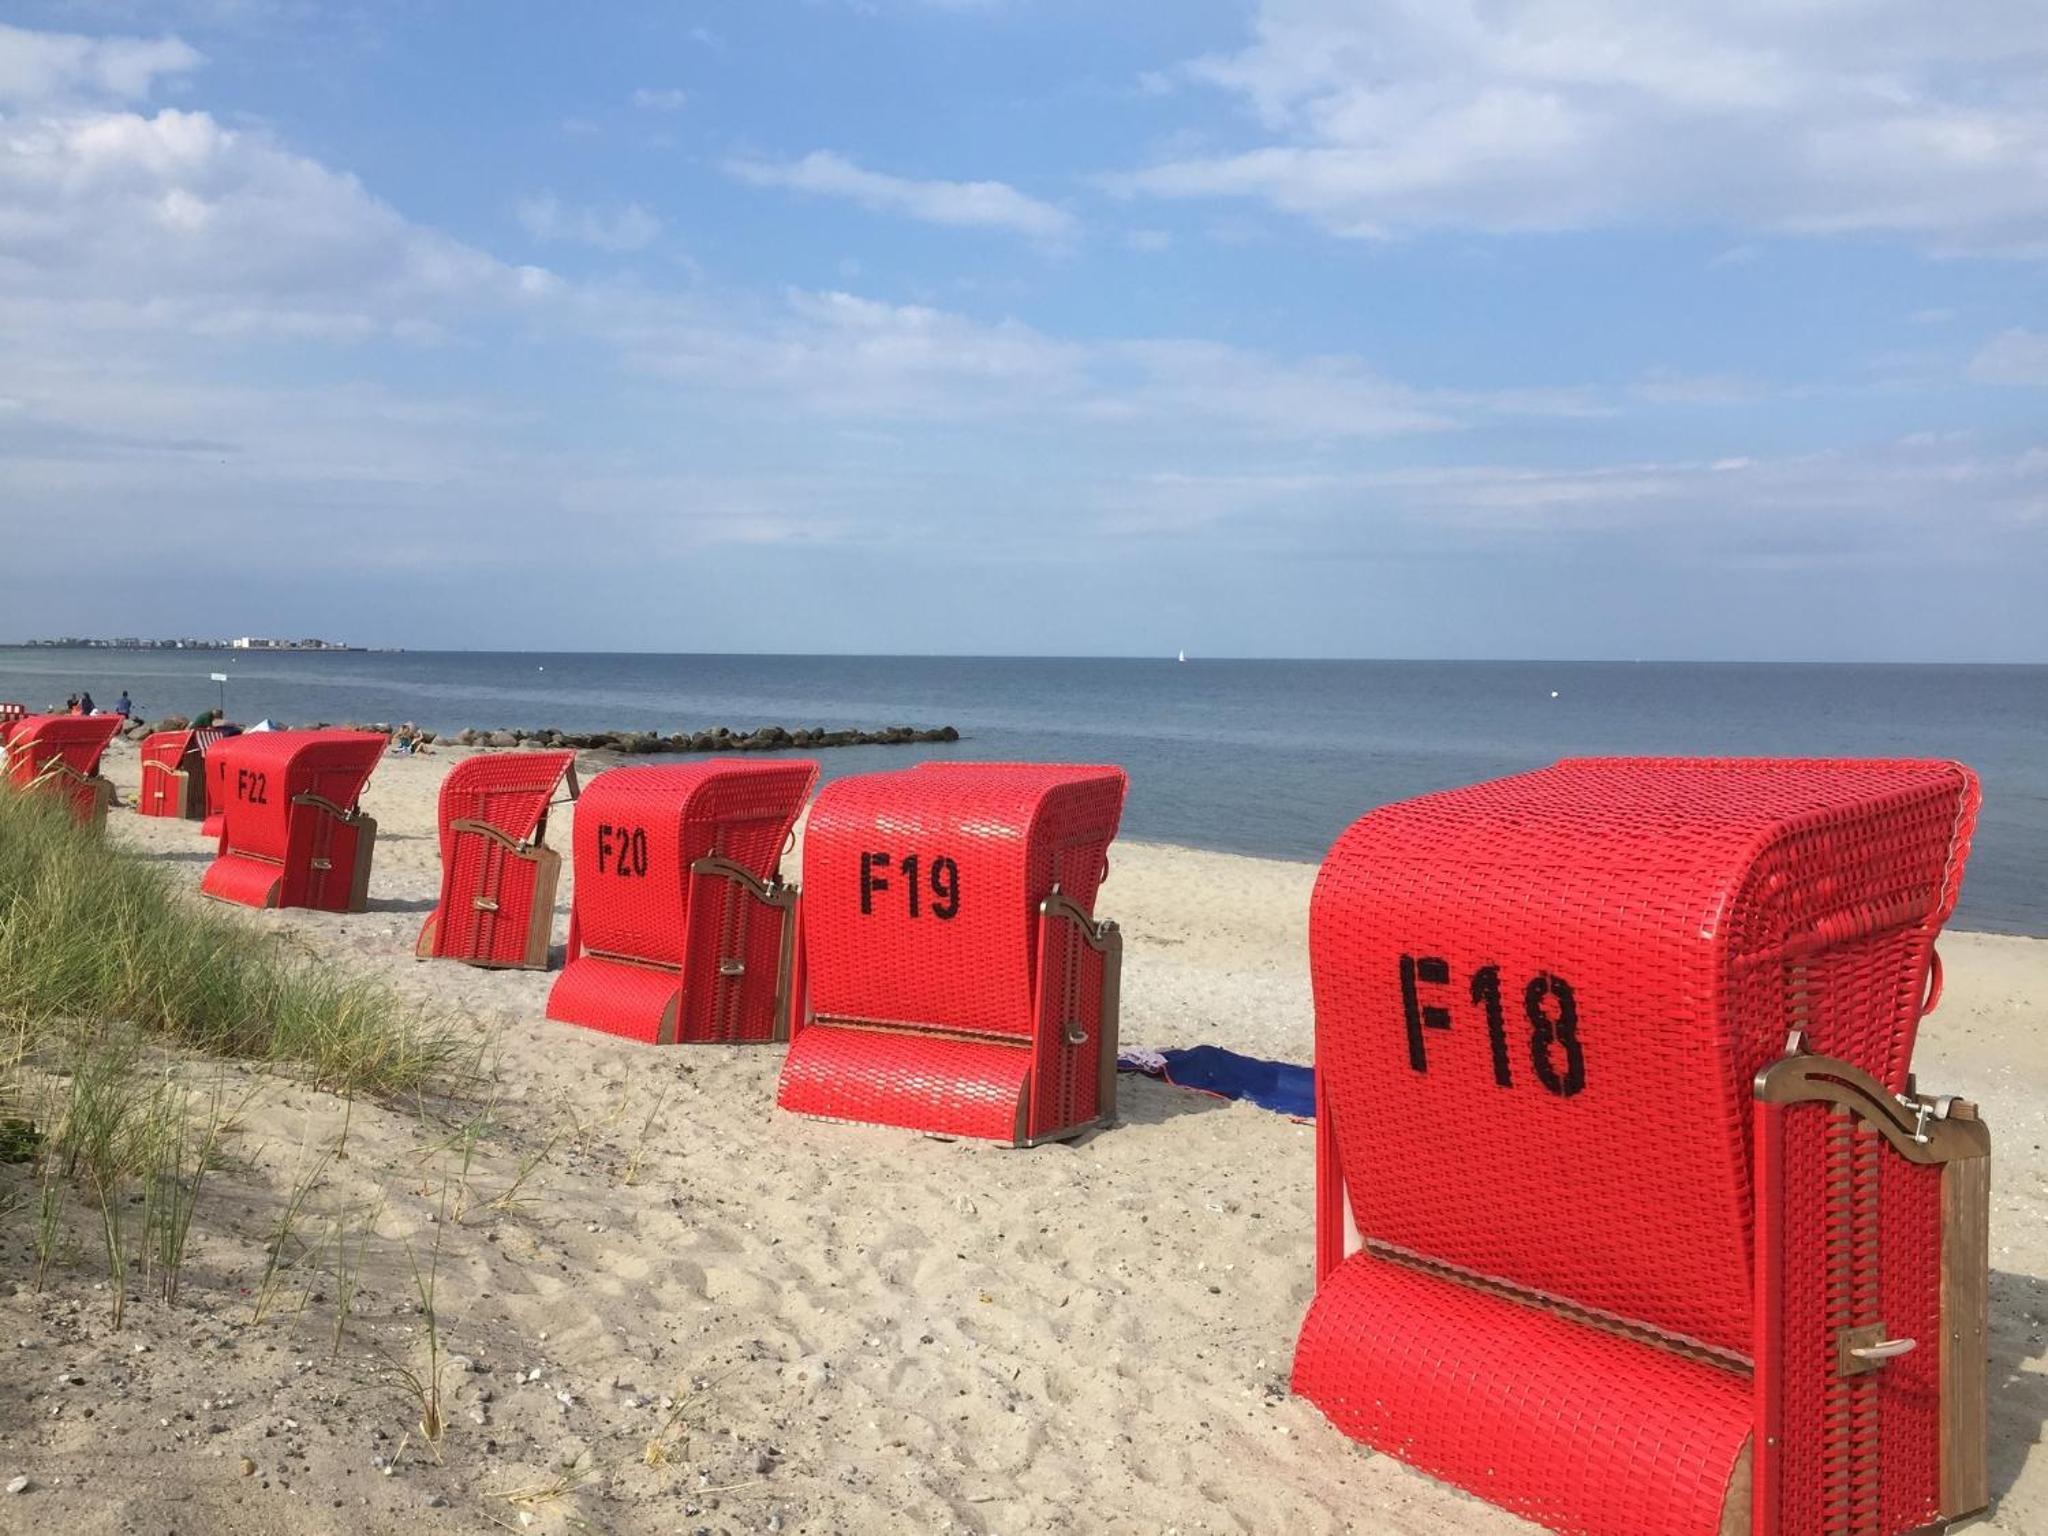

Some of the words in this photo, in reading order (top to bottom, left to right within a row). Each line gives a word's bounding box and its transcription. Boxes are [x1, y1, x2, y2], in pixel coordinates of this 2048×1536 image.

[239, 769, 267, 805] F22
[598, 825, 647, 877] F20
[860, 852, 960, 920] F19
[1400, 953, 1586, 1098] F18
